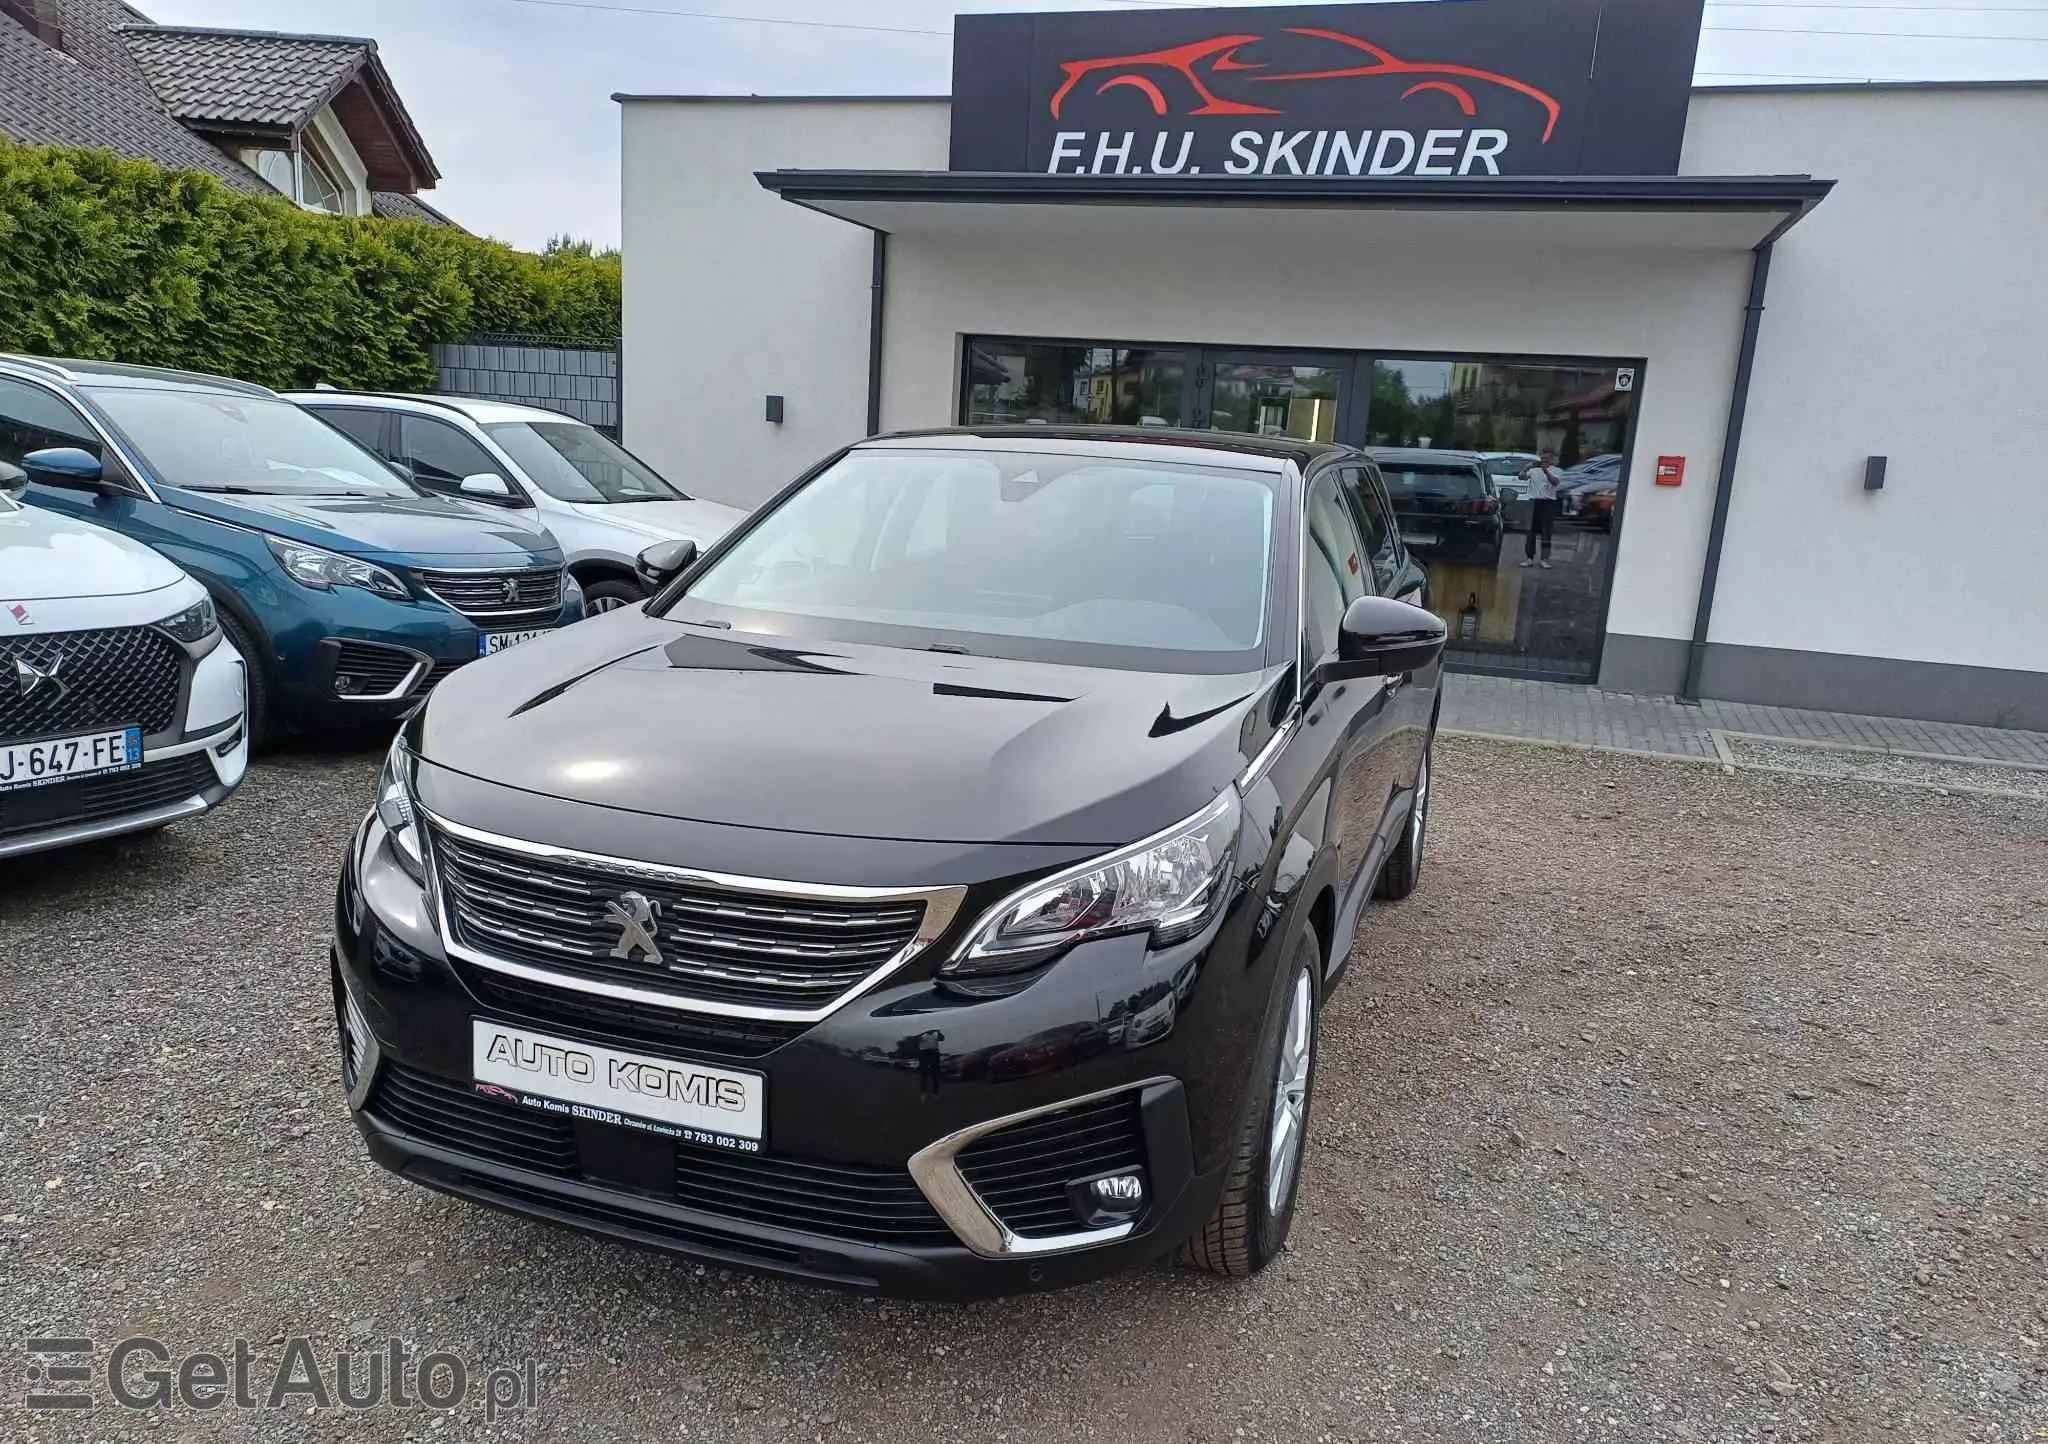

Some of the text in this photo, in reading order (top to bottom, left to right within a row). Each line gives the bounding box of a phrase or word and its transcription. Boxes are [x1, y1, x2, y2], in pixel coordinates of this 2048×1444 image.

[1047, 129, 1509, 176] F.H.U. SKINDER
[486, 1034, 746, 1113] AUTO KOMIS
[522, 1095, 542, 1108] Auto
[543, 1100, 570, 1114] Komis
[571, 1105, 622, 1126] SKINDER
[694, 1130, 714, 1144] 793
[716, 1135, 736, 1149] 002
[738, 1139, 759, 1153] 309
